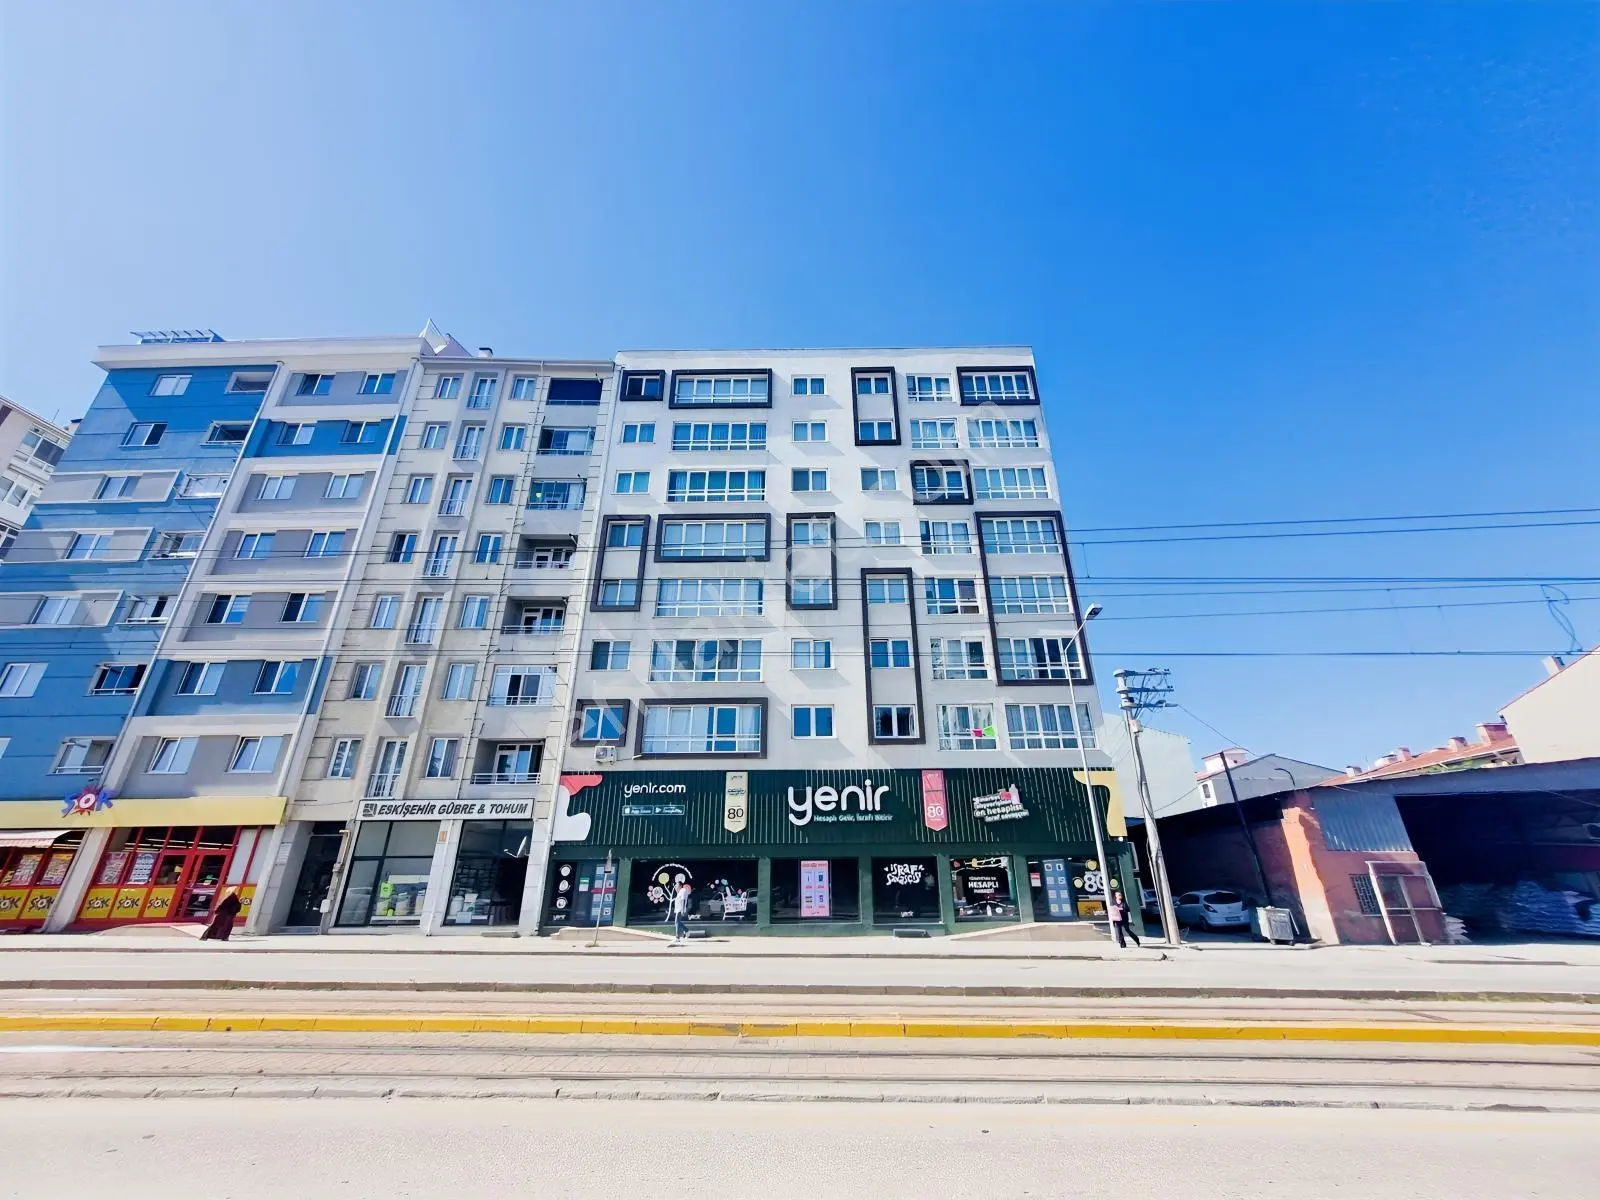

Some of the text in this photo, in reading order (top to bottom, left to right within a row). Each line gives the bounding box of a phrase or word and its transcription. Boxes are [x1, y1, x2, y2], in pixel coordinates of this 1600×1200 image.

[624, 781, 687, 798] yenir.com
[377, 801, 529, 818] ESKİŞEHİR GÜBRE & TOHUM
[787, 778, 890, 827] yenir
[727, 807, 744, 820] 80
[927, 805, 944, 818] 80
[968, 881, 999, 889] HESAPLI
